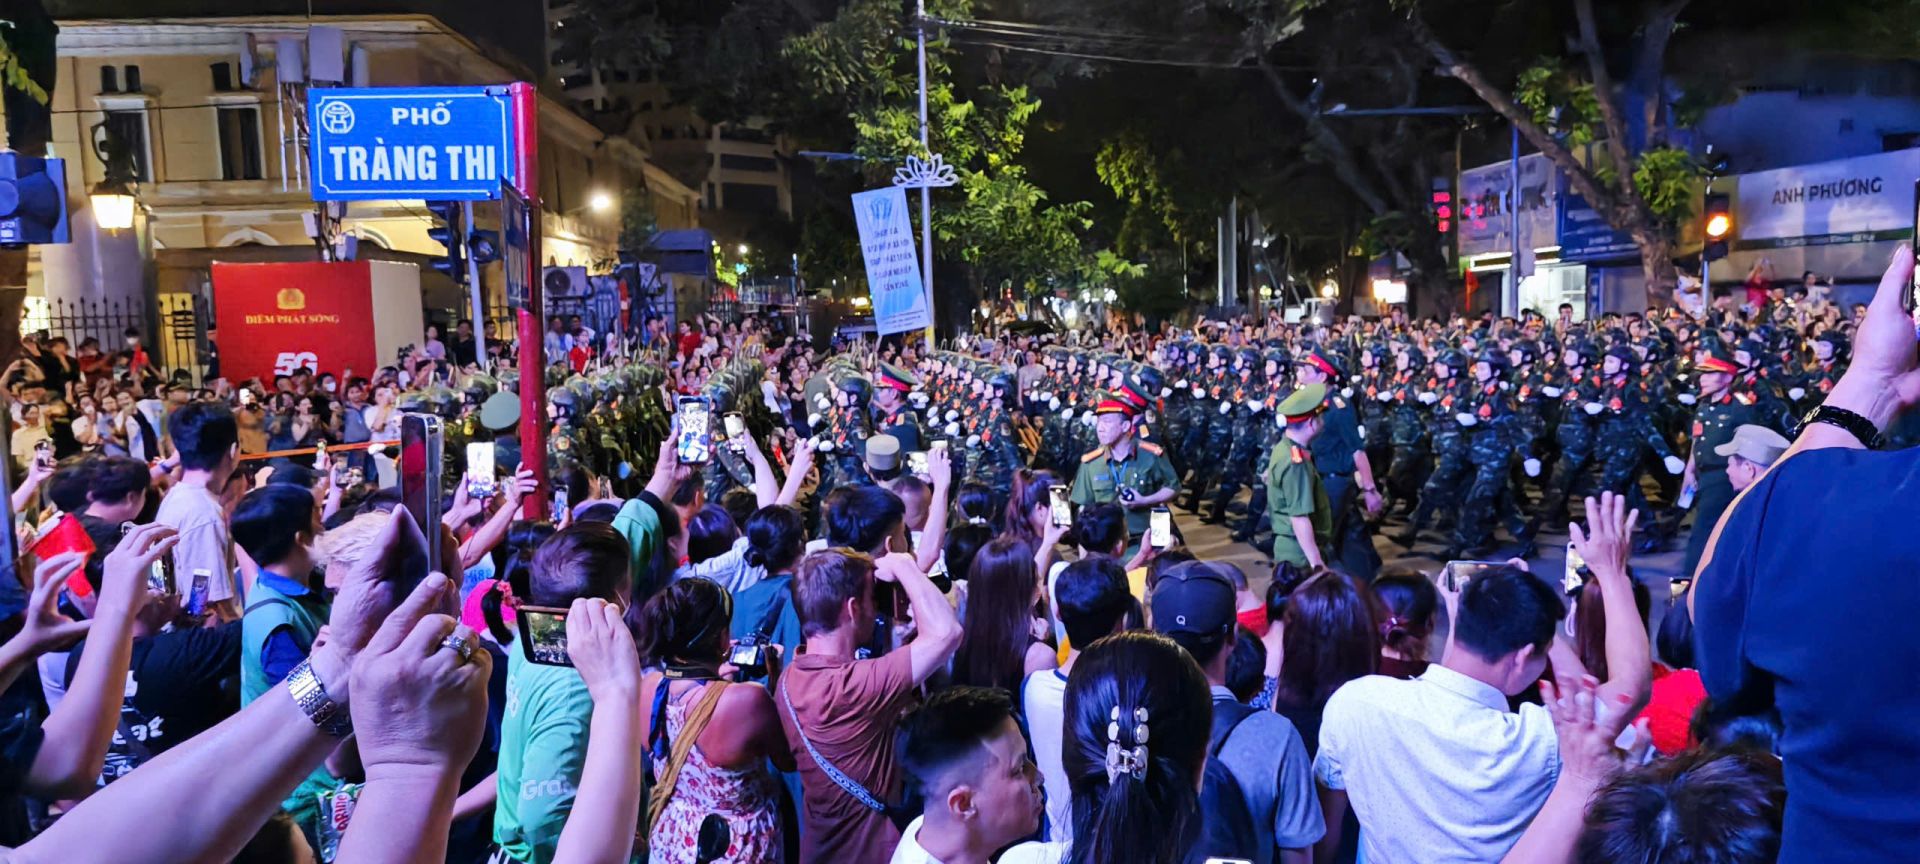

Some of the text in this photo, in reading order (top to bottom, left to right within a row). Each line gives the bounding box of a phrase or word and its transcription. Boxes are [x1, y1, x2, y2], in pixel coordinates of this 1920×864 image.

[392, 100, 452, 126] PHỐ
[329, 137, 496, 181] TRÀNG THI
[1772, 176, 1883, 205] ANH PHƯƠNG
[273, 351, 318, 376] 5G
